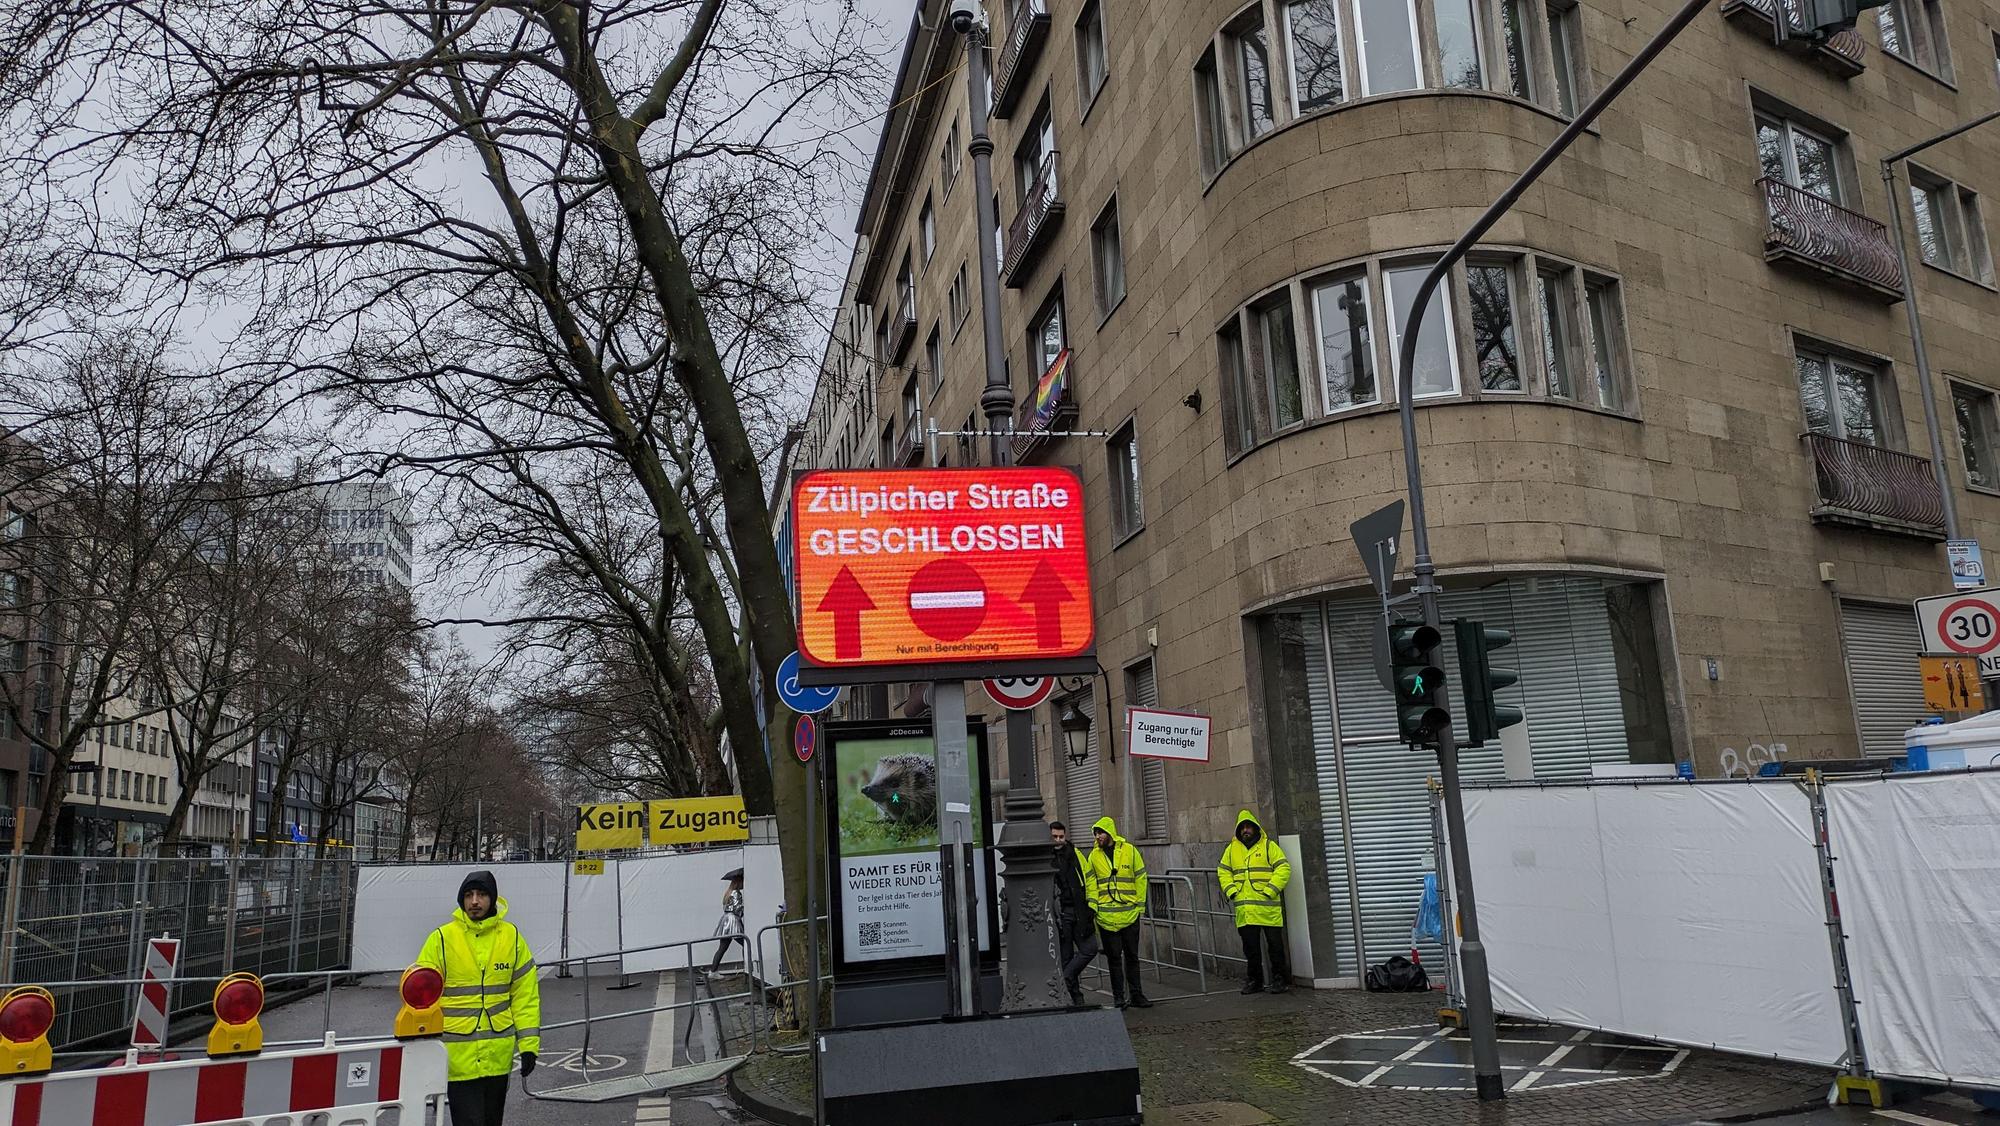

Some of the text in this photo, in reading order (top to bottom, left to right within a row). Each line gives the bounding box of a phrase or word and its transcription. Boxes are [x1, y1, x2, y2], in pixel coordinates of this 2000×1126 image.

[806, 482, 1069, 519] Zülpicher Straße
[809, 523, 1065, 557] GESCHLOSSEN
[1950, 612, 1992, 640] 30
[896, 642, 999, 654] Nur mit Berechtigung
[1979, 656, 2000, 671] NE
[1137, 721, 1203, 736] Zugang nur für
[1145, 734, 1196, 748] Berechtigte
[576, 805, 749, 832] Kein Zugang
[849, 865, 890, 878] DAMIT
[893, 864, 906, 875] ES
[910, 861, 932, 874] FÜR
[849, 877, 892, 890] WIEDER
[895, 876, 926, 887] RUND
[858, 895, 870, 903] Der
[871, 894, 884, 904] Igel
[884, 893, 893, 901] ist
[906, 891, 920, 899] Tier
[920, 890, 933, 898] des
[858, 902, 911, 913] Er braucht Hilfe.
[494, 962, 510, 971] 304
